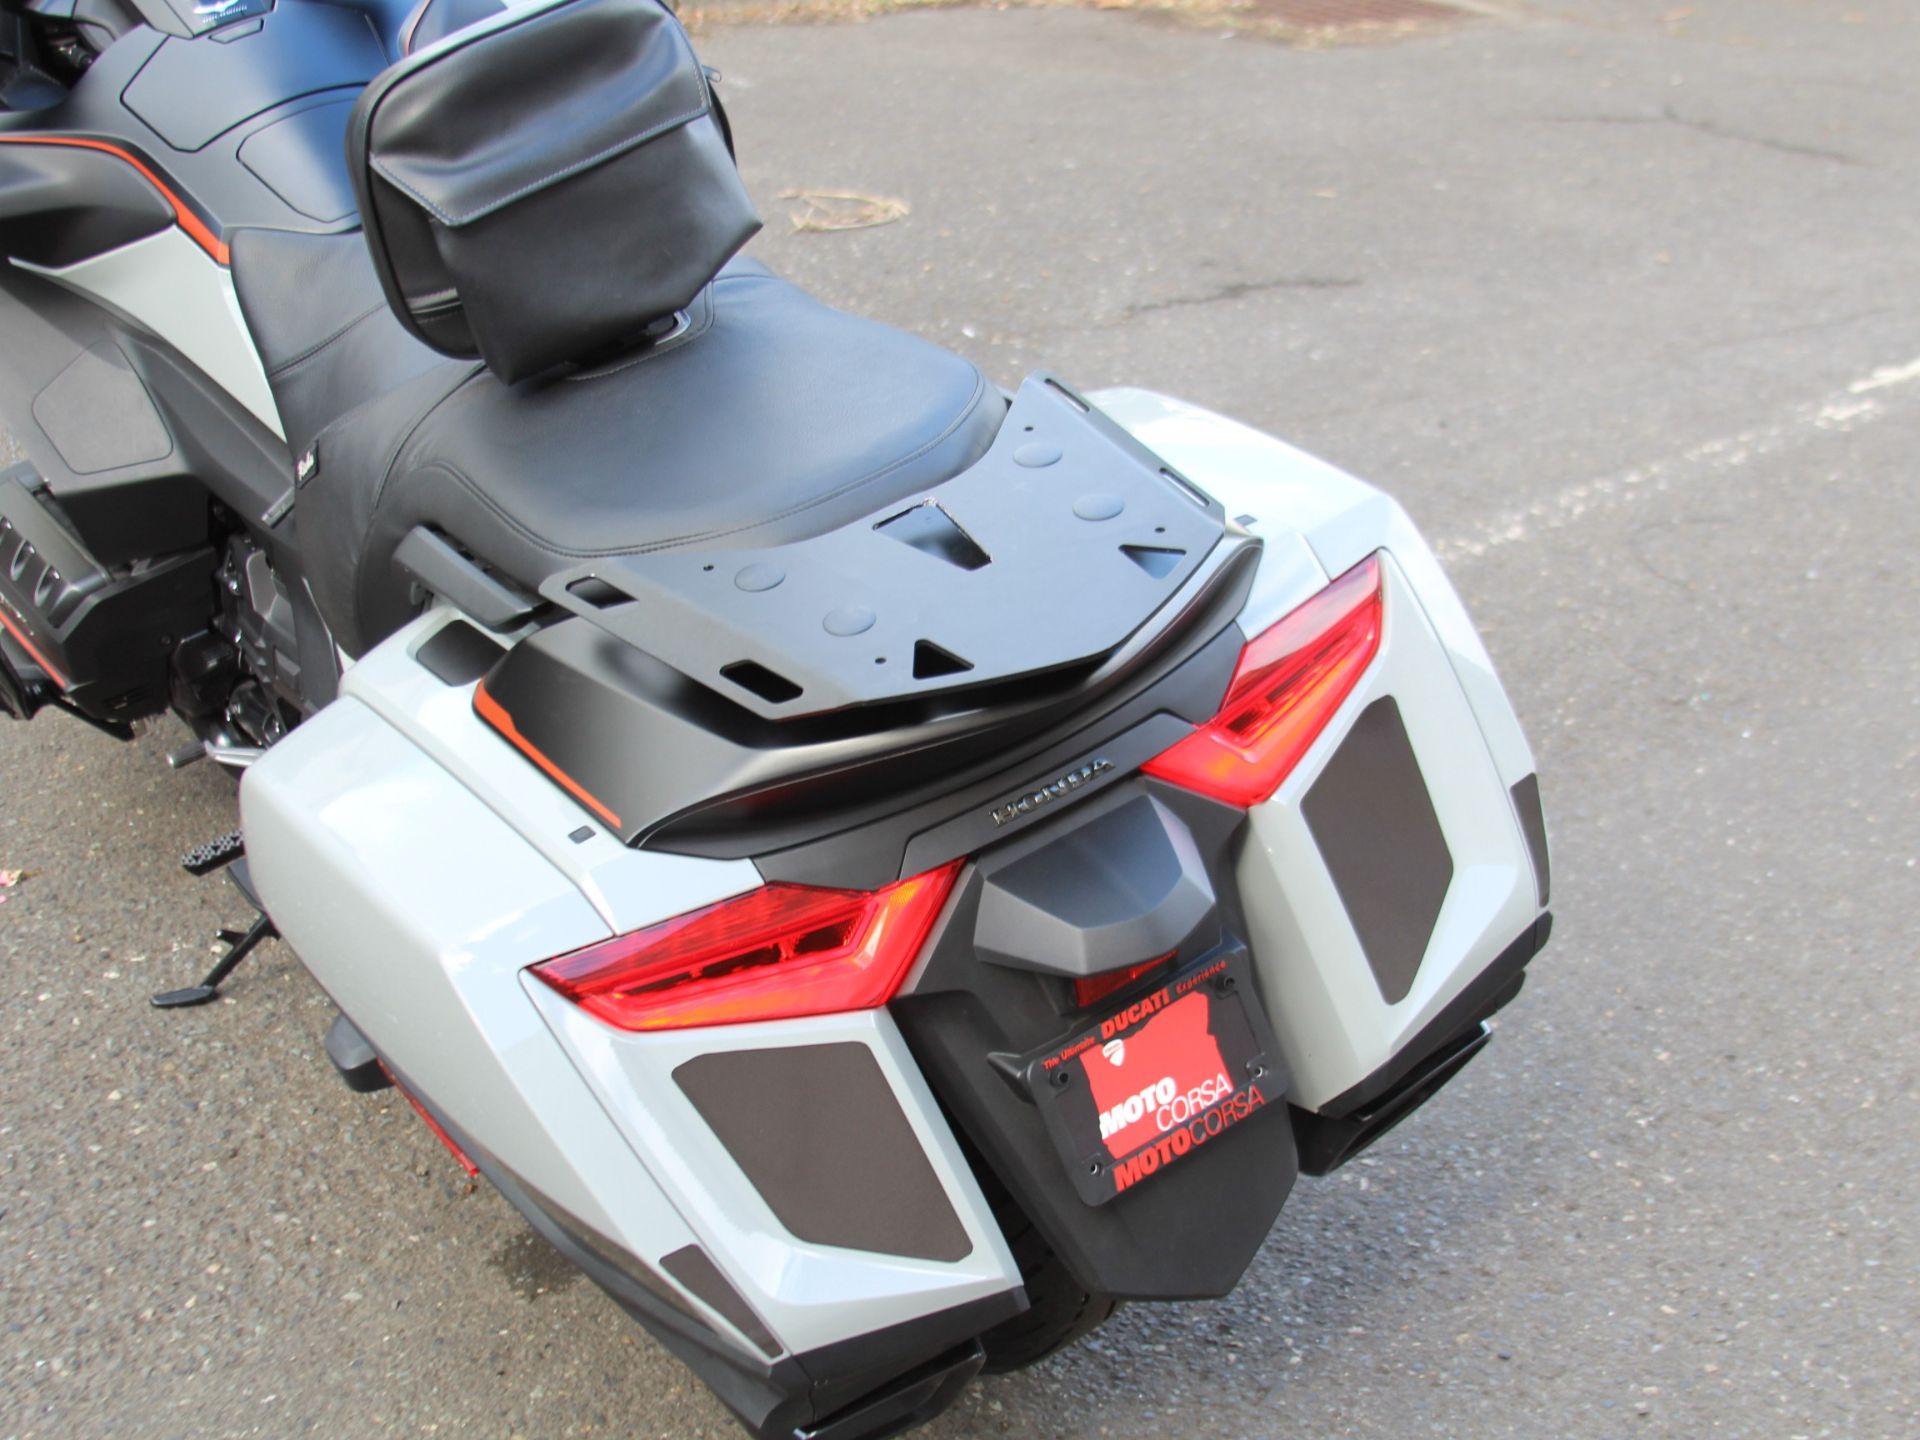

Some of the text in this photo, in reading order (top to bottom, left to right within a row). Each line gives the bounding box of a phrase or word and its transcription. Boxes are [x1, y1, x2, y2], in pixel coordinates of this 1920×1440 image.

[991, 757, 1116, 826] HONDA
[1100, 989, 1171, 1040] DUCATI
[1099, 1076, 1177, 1140] MOTO
[1155, 1073, 1233, 1132] CORSA
[1112, 1085, 1265, 1193] MOTOCORSA
